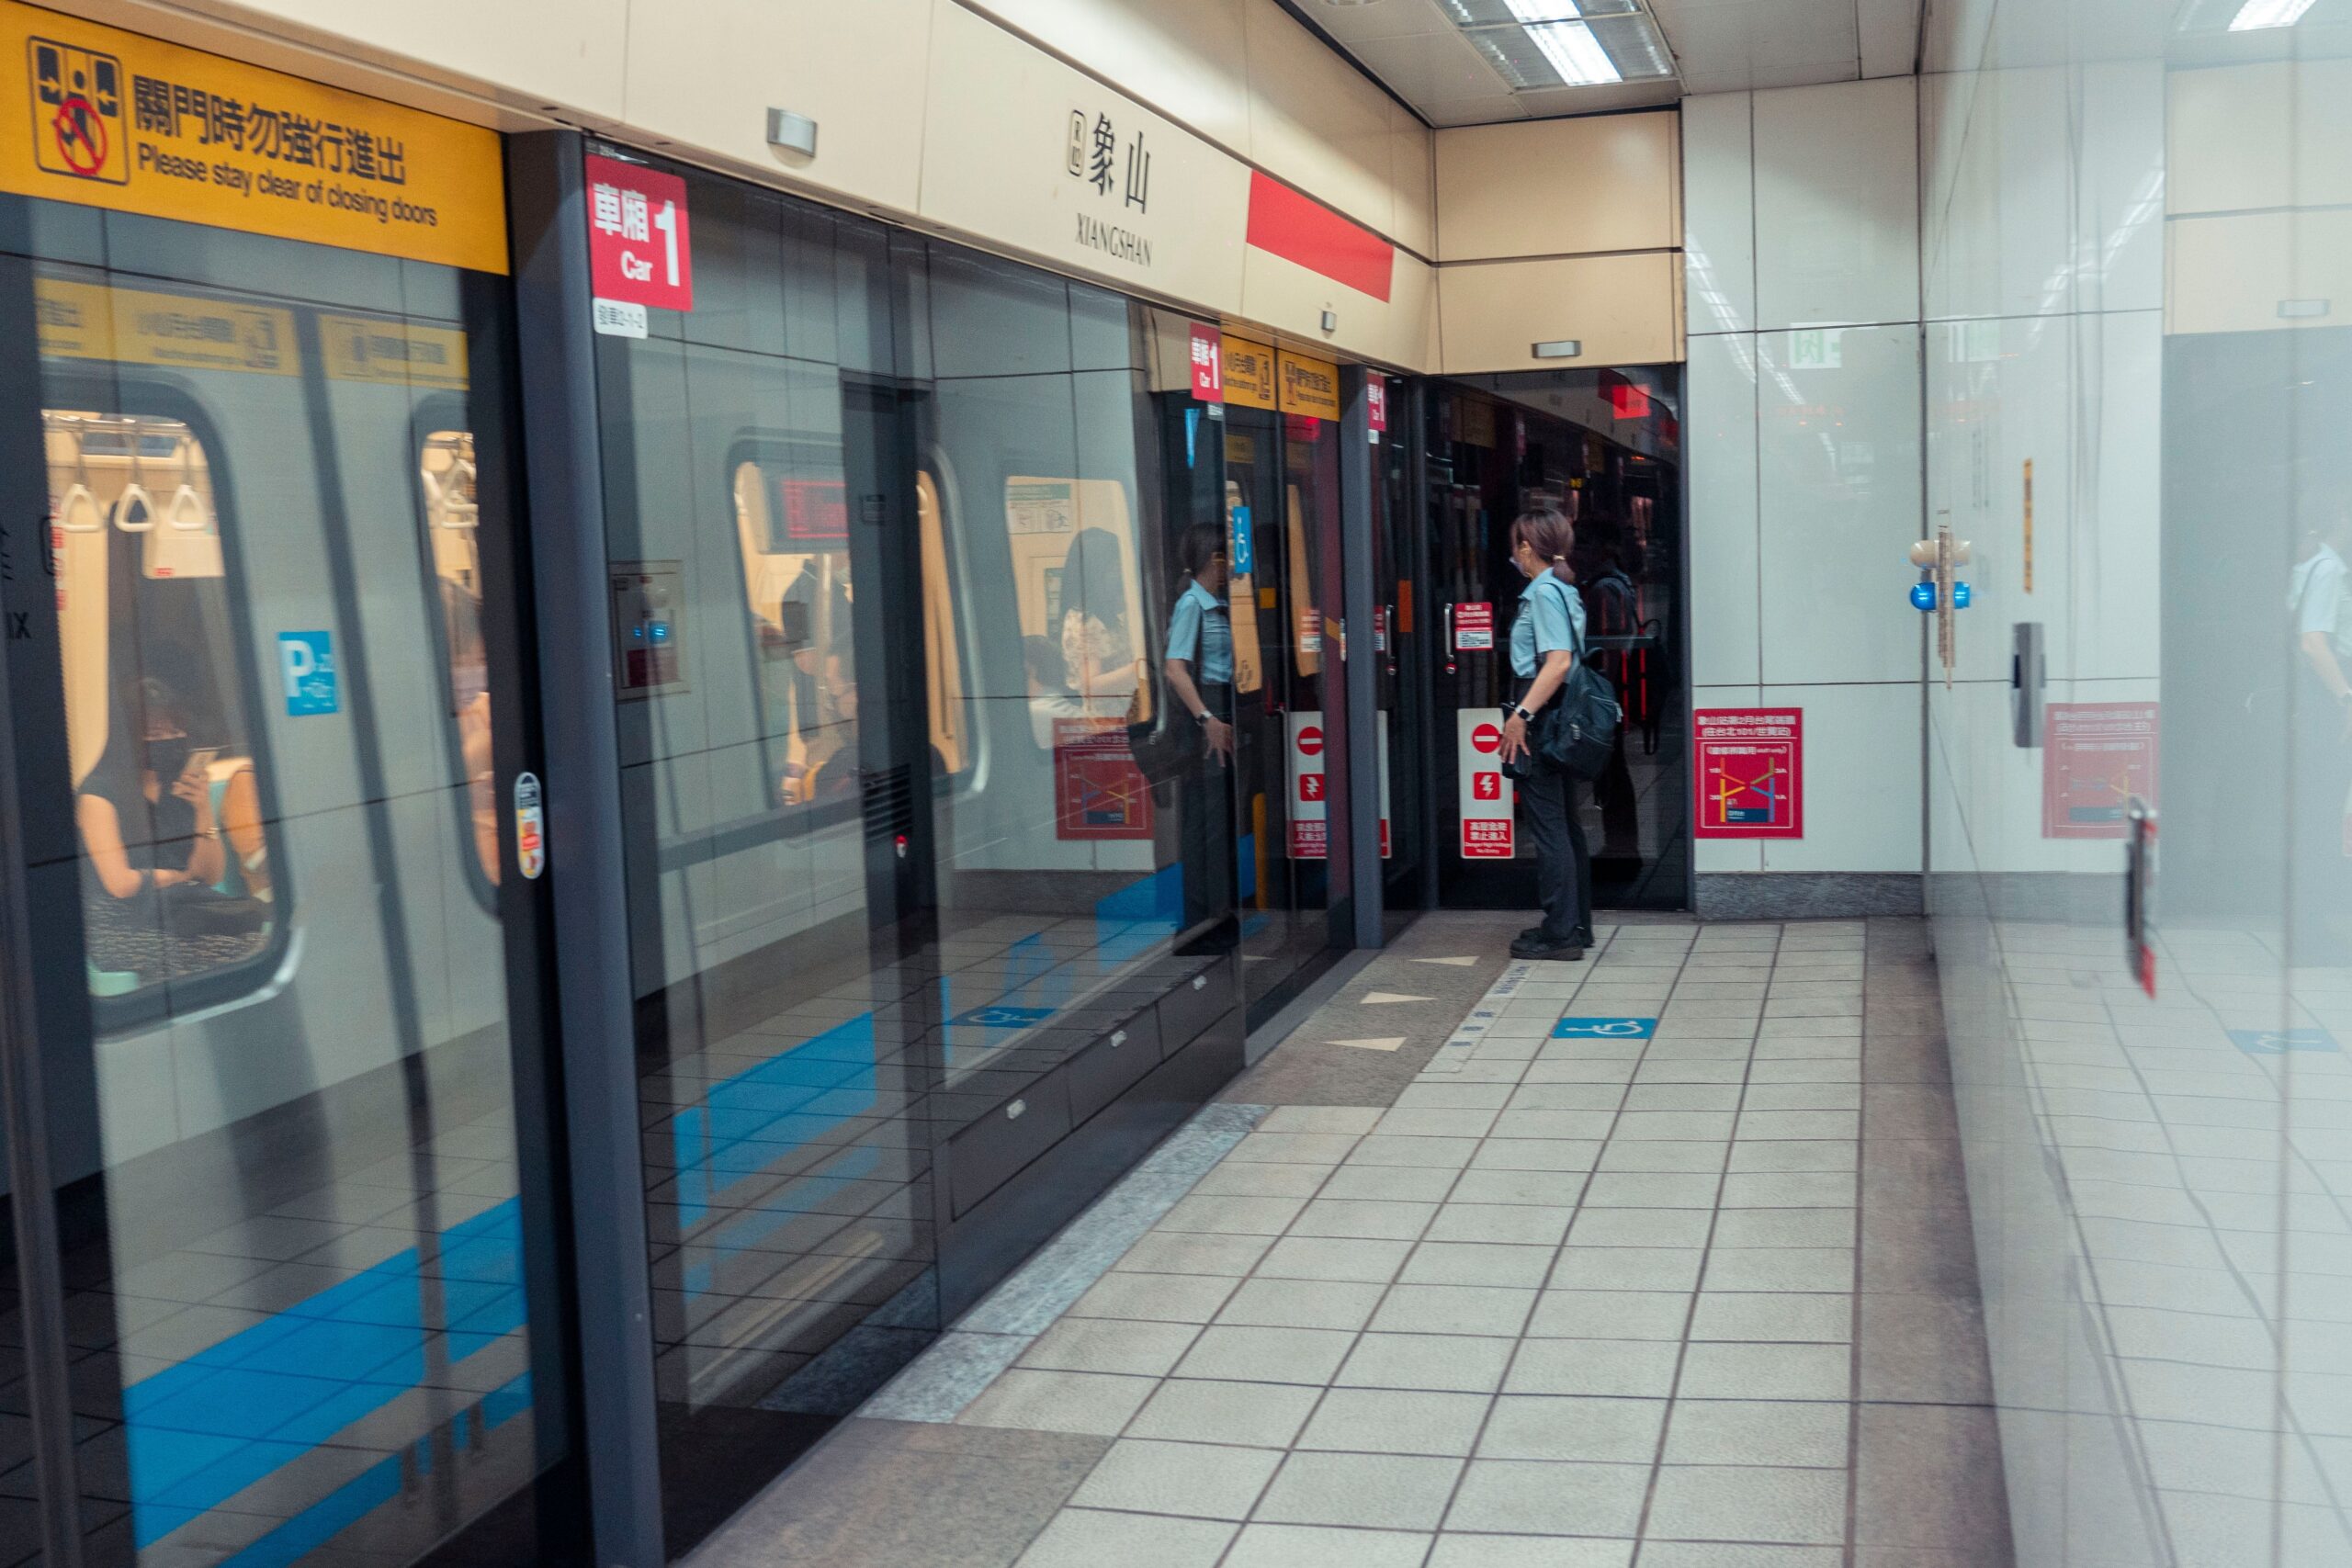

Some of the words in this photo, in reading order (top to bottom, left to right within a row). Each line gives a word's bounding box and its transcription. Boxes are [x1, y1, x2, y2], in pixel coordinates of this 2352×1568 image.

[133, 74, 405, 185] 關門時勿強行進出
[1089, 112, 1152, 215] 象山
[138, 141, 208, 182] Please
[212, 162, 253, 196] stay
[257, 169, 301, 201] clear
[306, 179, 322, 204] of
[327, 184, 389, 223] closing
[392, 197, 437, 227] doors
[593, 183, 650, 243] 車廂
[654, 200, 680, 287] 1
[620, 249, 653, 282] Car
[1075, 213, 1153, 267] XIANGSHAN
[1209, 342, 1220, 389] 1
[278, 639, 315, 698] P
